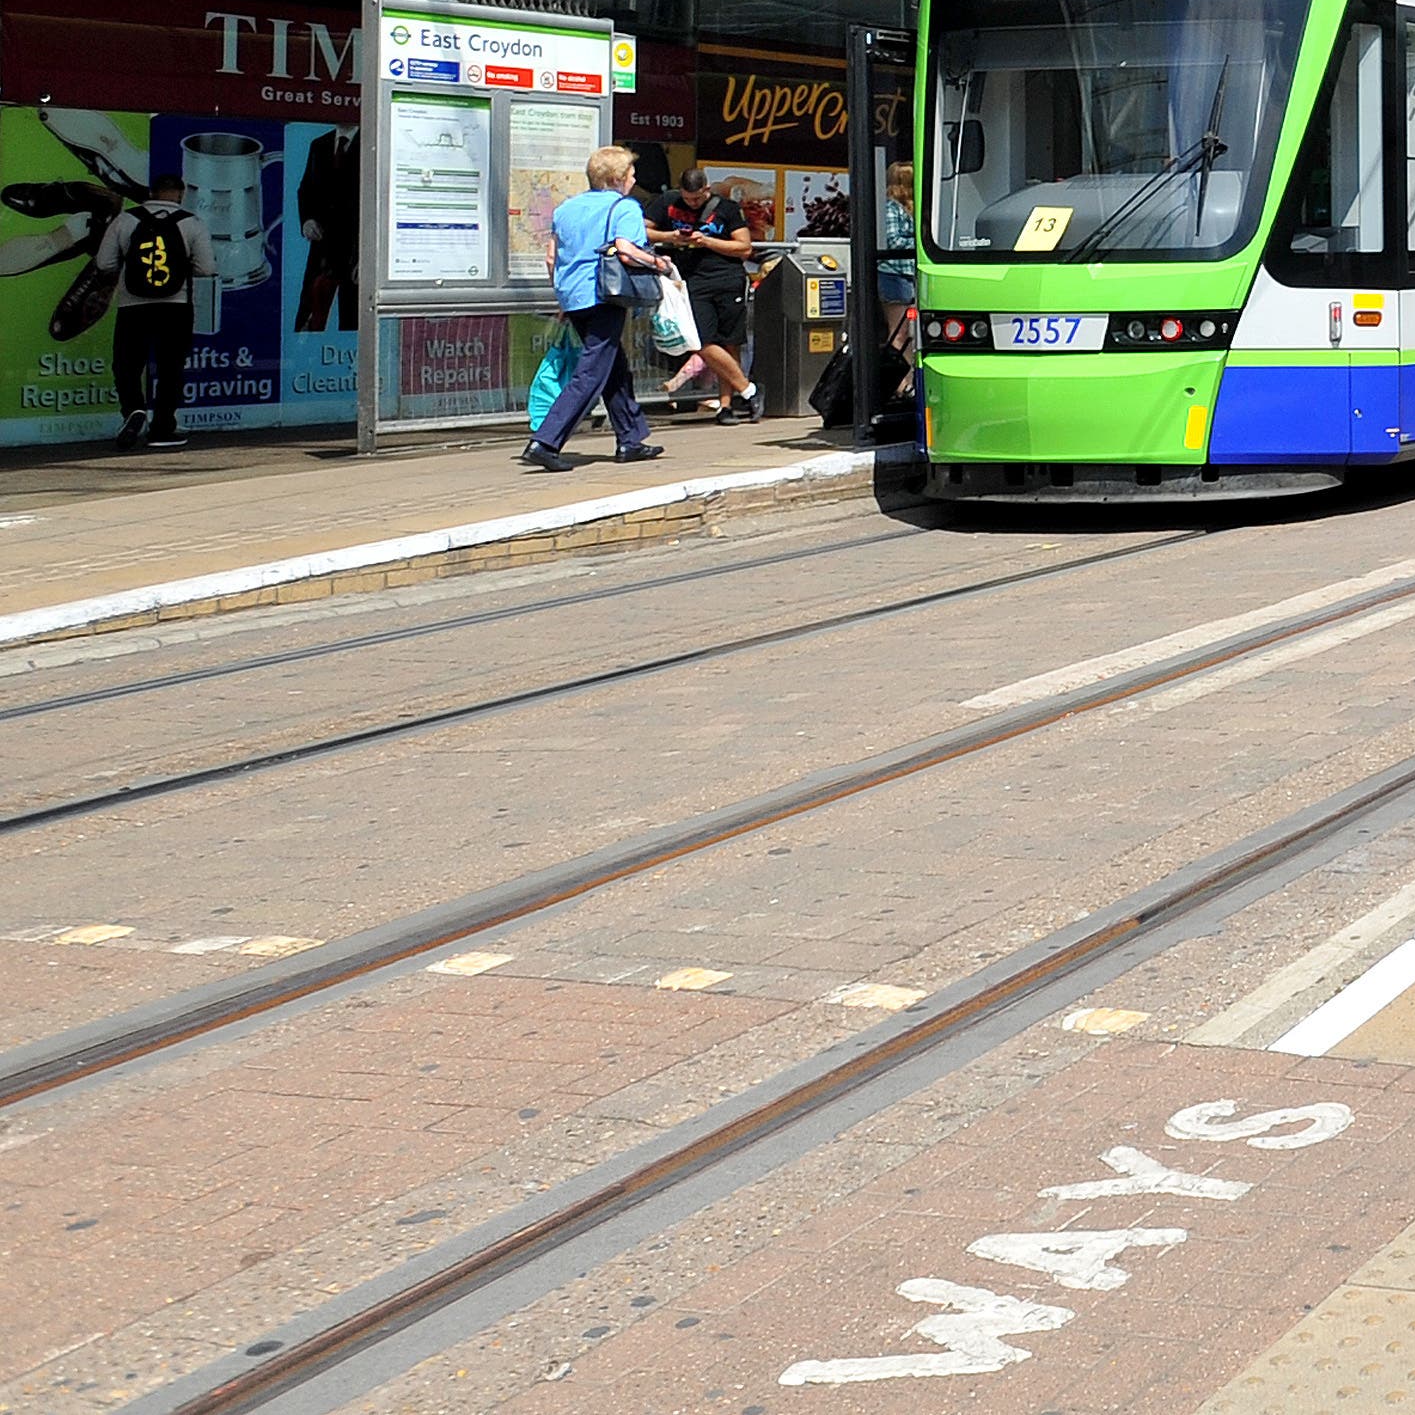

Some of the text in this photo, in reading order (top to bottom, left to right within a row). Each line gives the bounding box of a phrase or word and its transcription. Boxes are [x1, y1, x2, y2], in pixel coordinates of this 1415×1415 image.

[420, 29, 543, 59] East Croydon
[261, 86, 314, 104] Great
[630, 113, 684, 128] Est 1903
[721, 74, 906, 146] Upper Crst
[1033, 217, 1057, 232] 13
[1011, 317, 1082, 344] 2557
[235, 346, 254, 367] &
[424, 336, 485, 359] Watch
[38, 352, 106, 377] Shoe
[419, 363, 492, 389] Repairs
[20, 383, 119, 413] Repairs
[183, 411, 241, 425] TIMPSON
[776, 1097, 1357, 1386] WAYS
